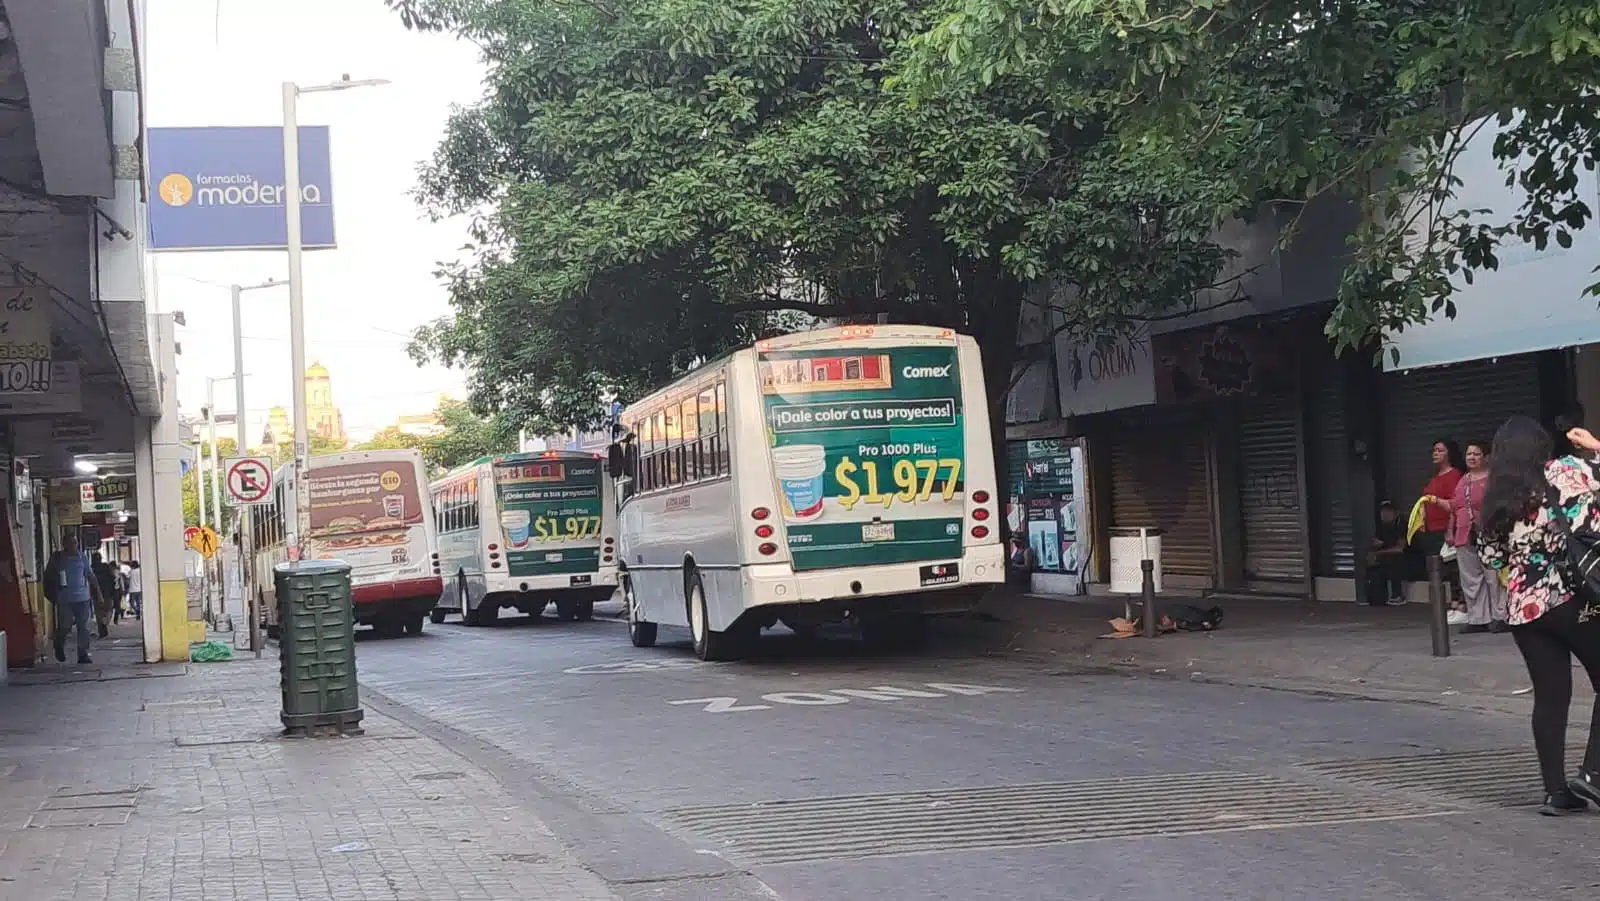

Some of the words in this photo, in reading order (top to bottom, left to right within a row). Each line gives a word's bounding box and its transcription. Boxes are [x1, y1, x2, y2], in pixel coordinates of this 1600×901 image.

[197, 173, 252, 185] farmacias
[198, 181, 320, 205] modera
[902, 363, 952, 379] Comex
[1088, 345, 1137, 381] OXUM
[776, 410, 812, 428] ¡Dale
[815, 408, 848, 421] color
[851, 410, 860, 420] a
[862, 407, 884, 419] tus
[886, 403, 951, 421] proyectos!
[858, 445, 879, 456] Pro
[881, 444, 910, 456] 1000
[913, 443, 937, 454] Plus
[835, 456, 962, 511] $1,977
[534, 515, 601, 544] $1,977
